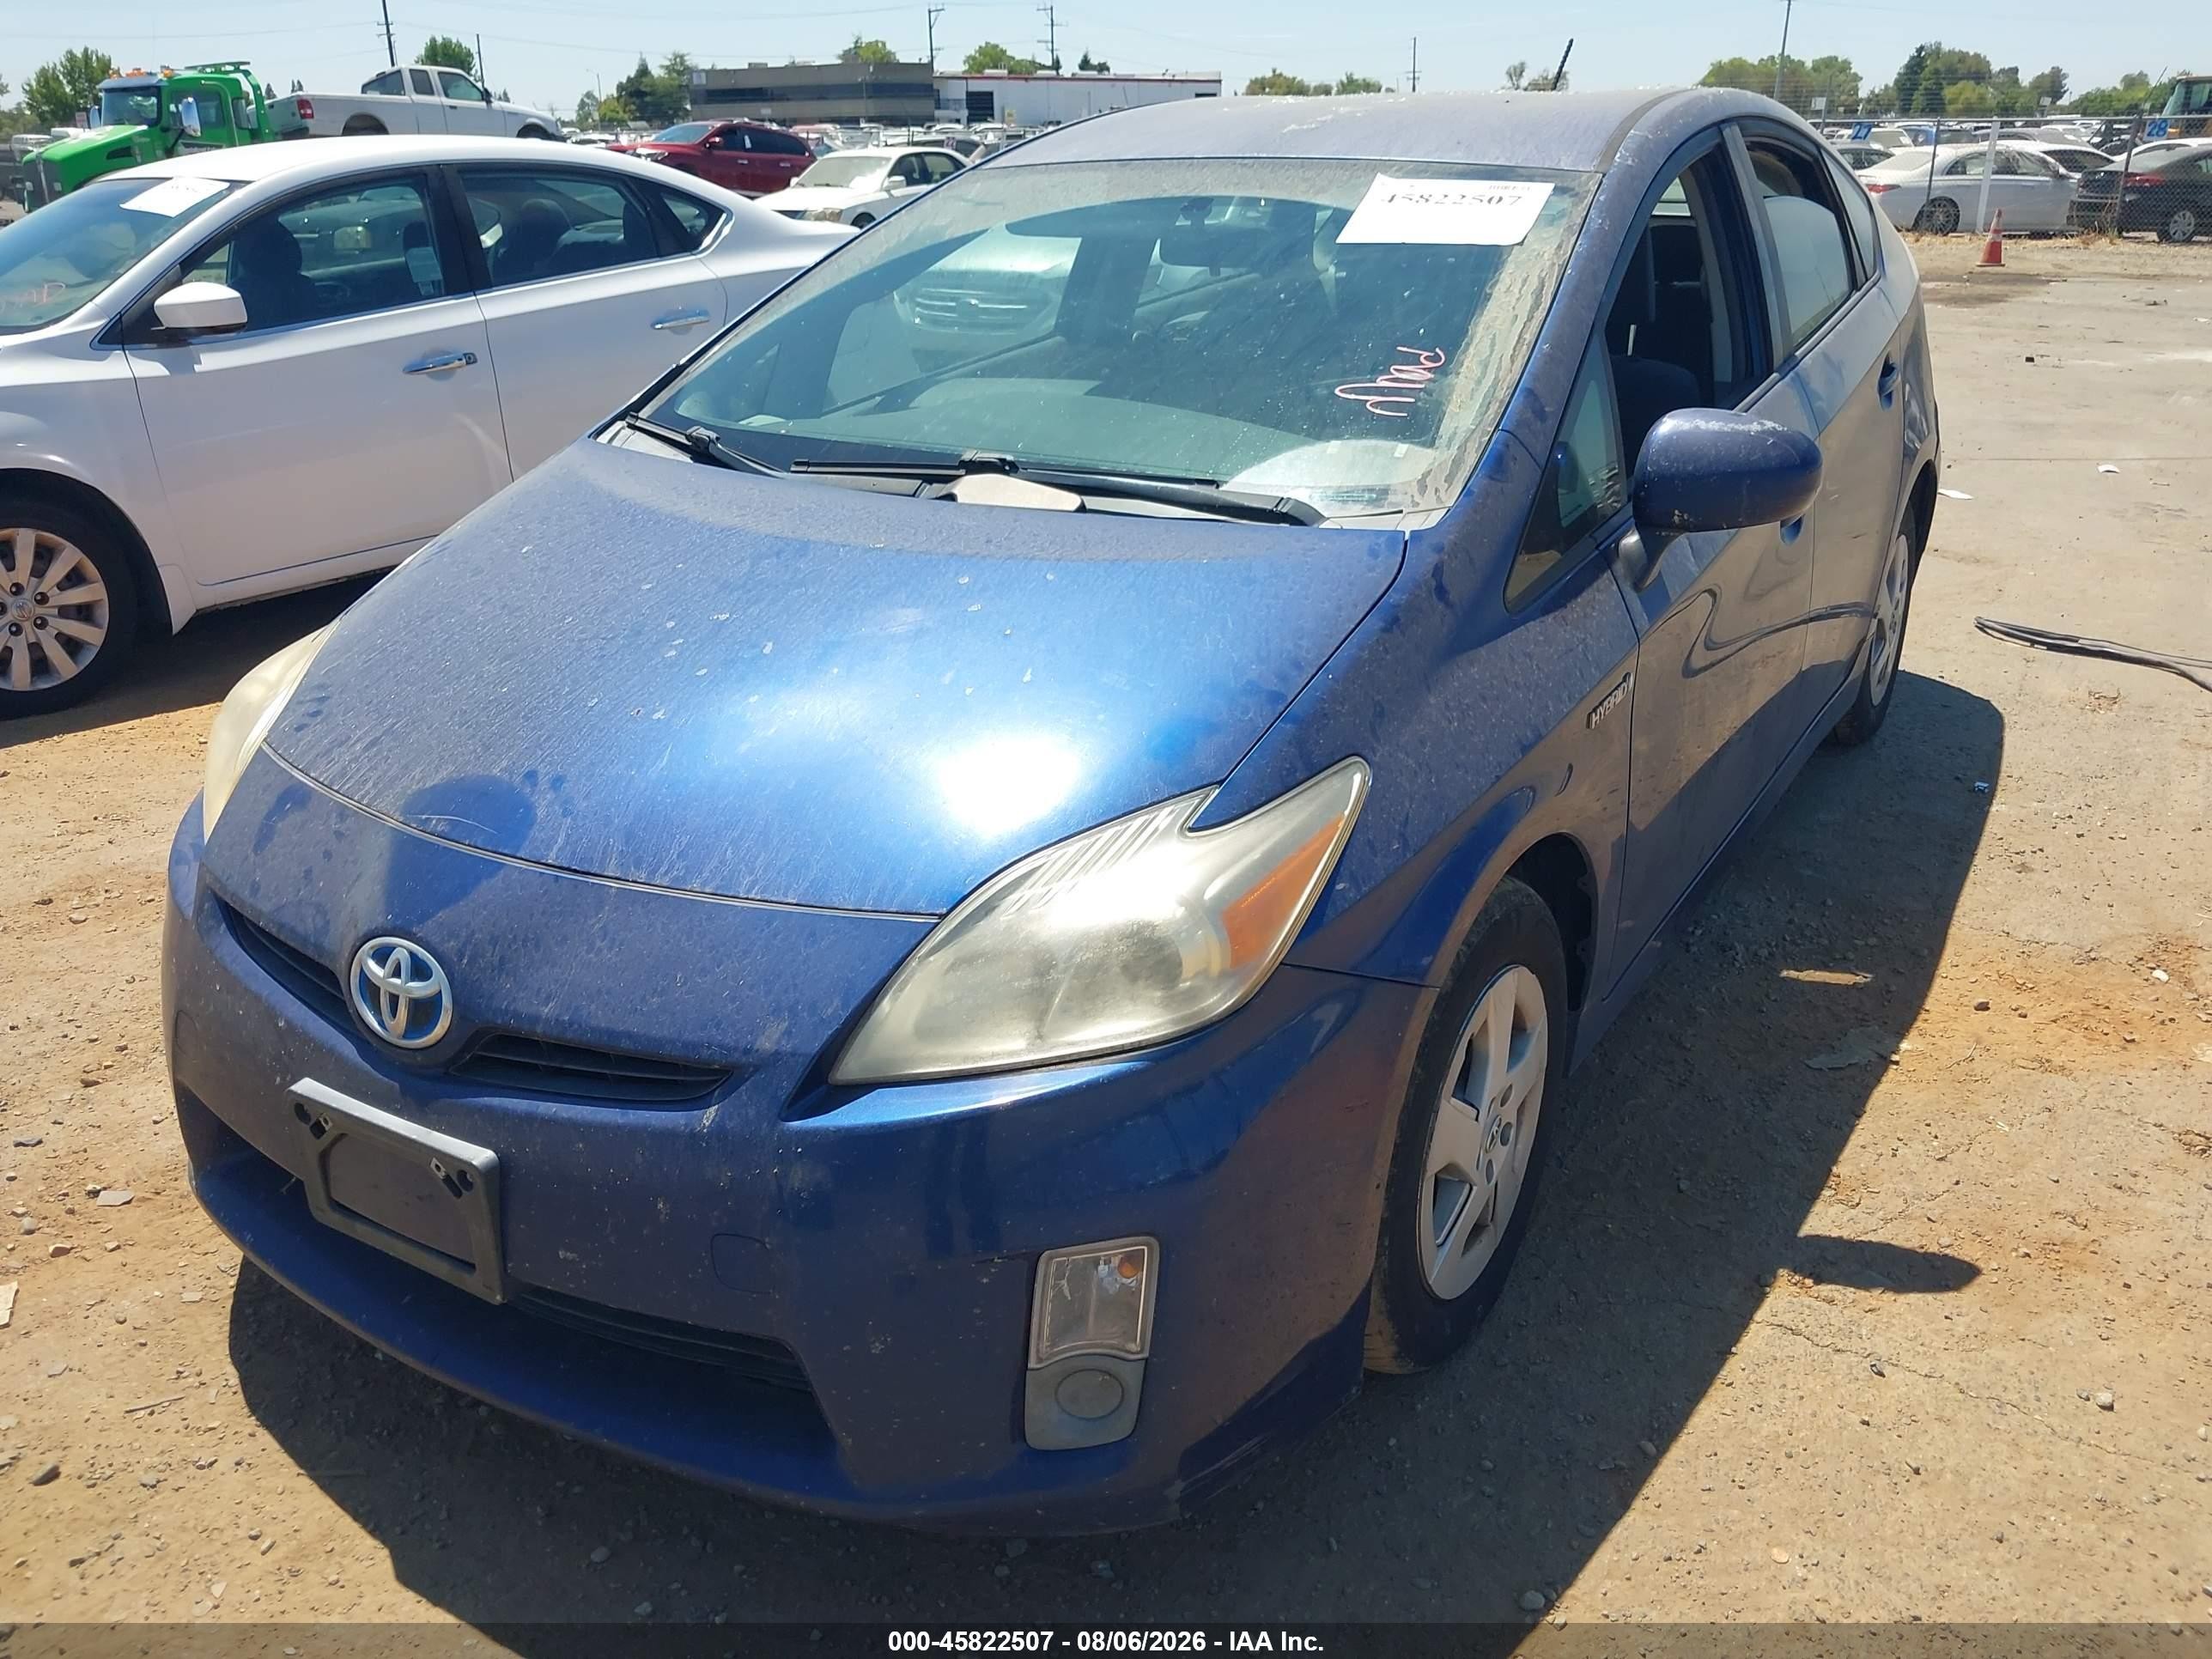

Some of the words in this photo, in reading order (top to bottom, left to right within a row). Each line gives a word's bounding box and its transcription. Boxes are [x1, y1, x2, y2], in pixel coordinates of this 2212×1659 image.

[1851, 123, 1872, 141] 27
[2147, 121, 2169, 137] 28
[1591, 682, 1627, 729] HYBRID
